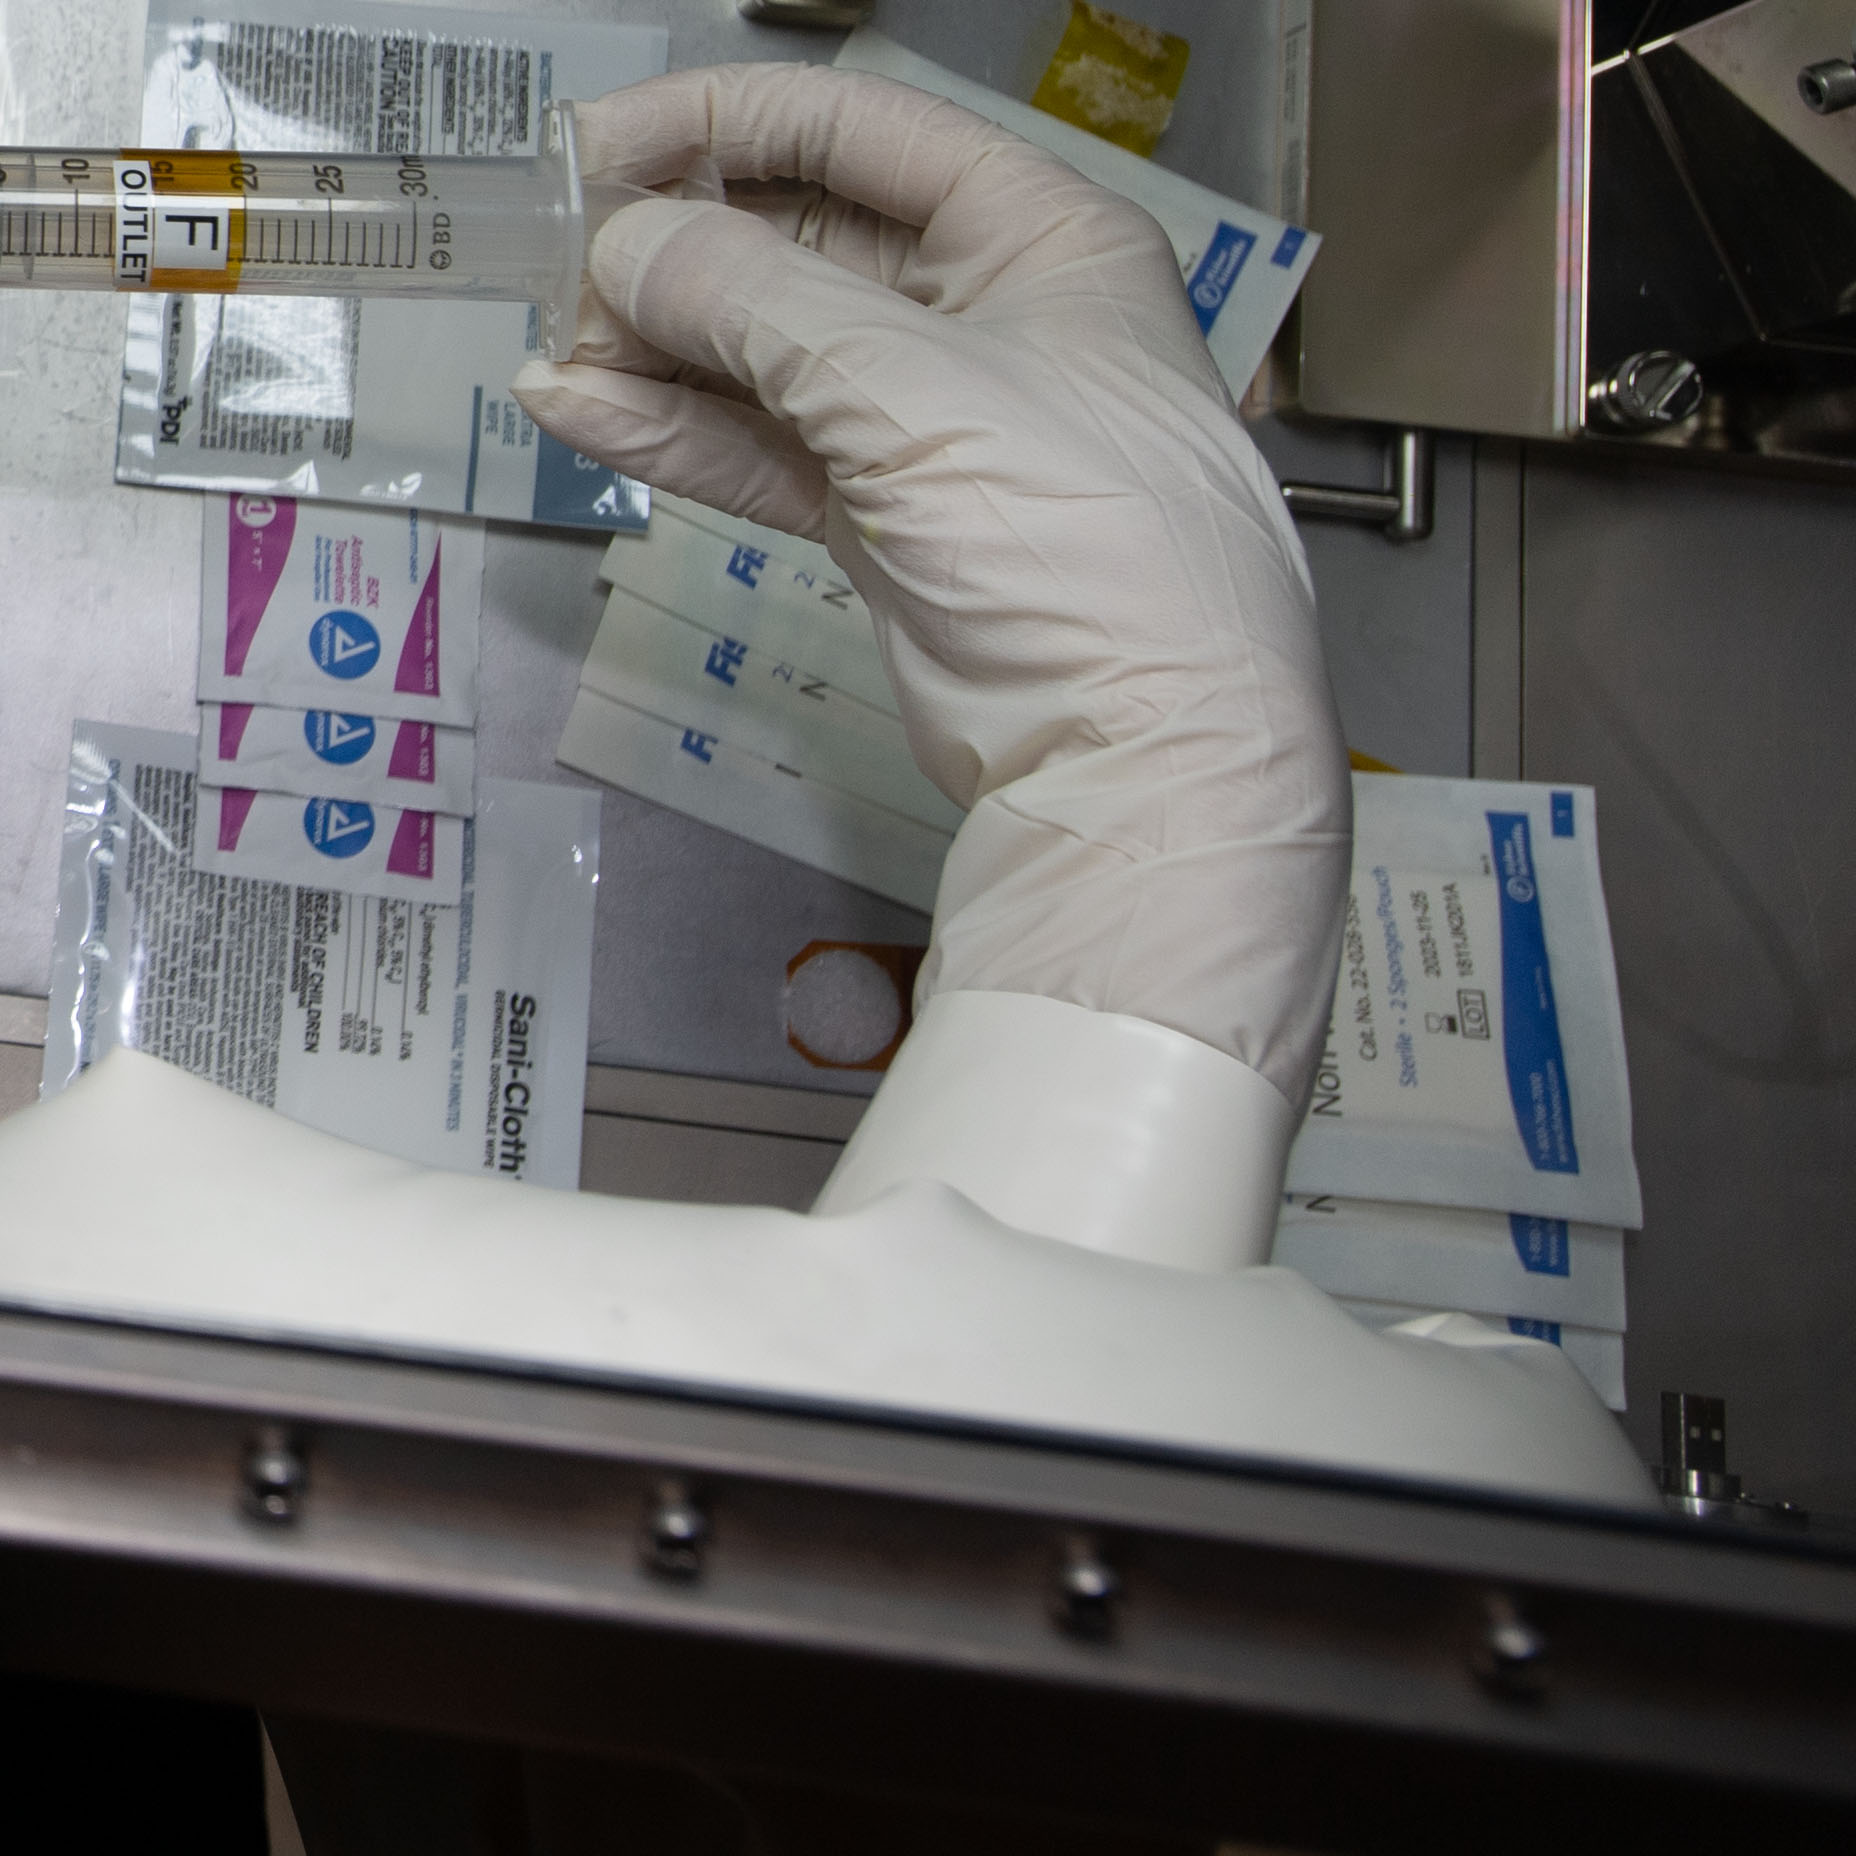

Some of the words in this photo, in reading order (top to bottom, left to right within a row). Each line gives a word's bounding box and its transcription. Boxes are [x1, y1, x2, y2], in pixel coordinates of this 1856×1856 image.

[62, 159, 90, 184] 10
[230, 162, 258, 191] 20
[315, 164, 344, 193] 25
[120, 169, 148, 282] OUTLET
[165, 215, 219, 251] F
[433, 213, 451, 245] BD
[333, 538, 347, 604] Towelette
[347, 535, 364, 605] Antiseptic
[312, 894, 329, 944] REACH
[311, 947, 326, 969] OF
[304, 972, 324, 1053] CHILDREN
[498, 993, 537, 1173] Sani-Cloth
